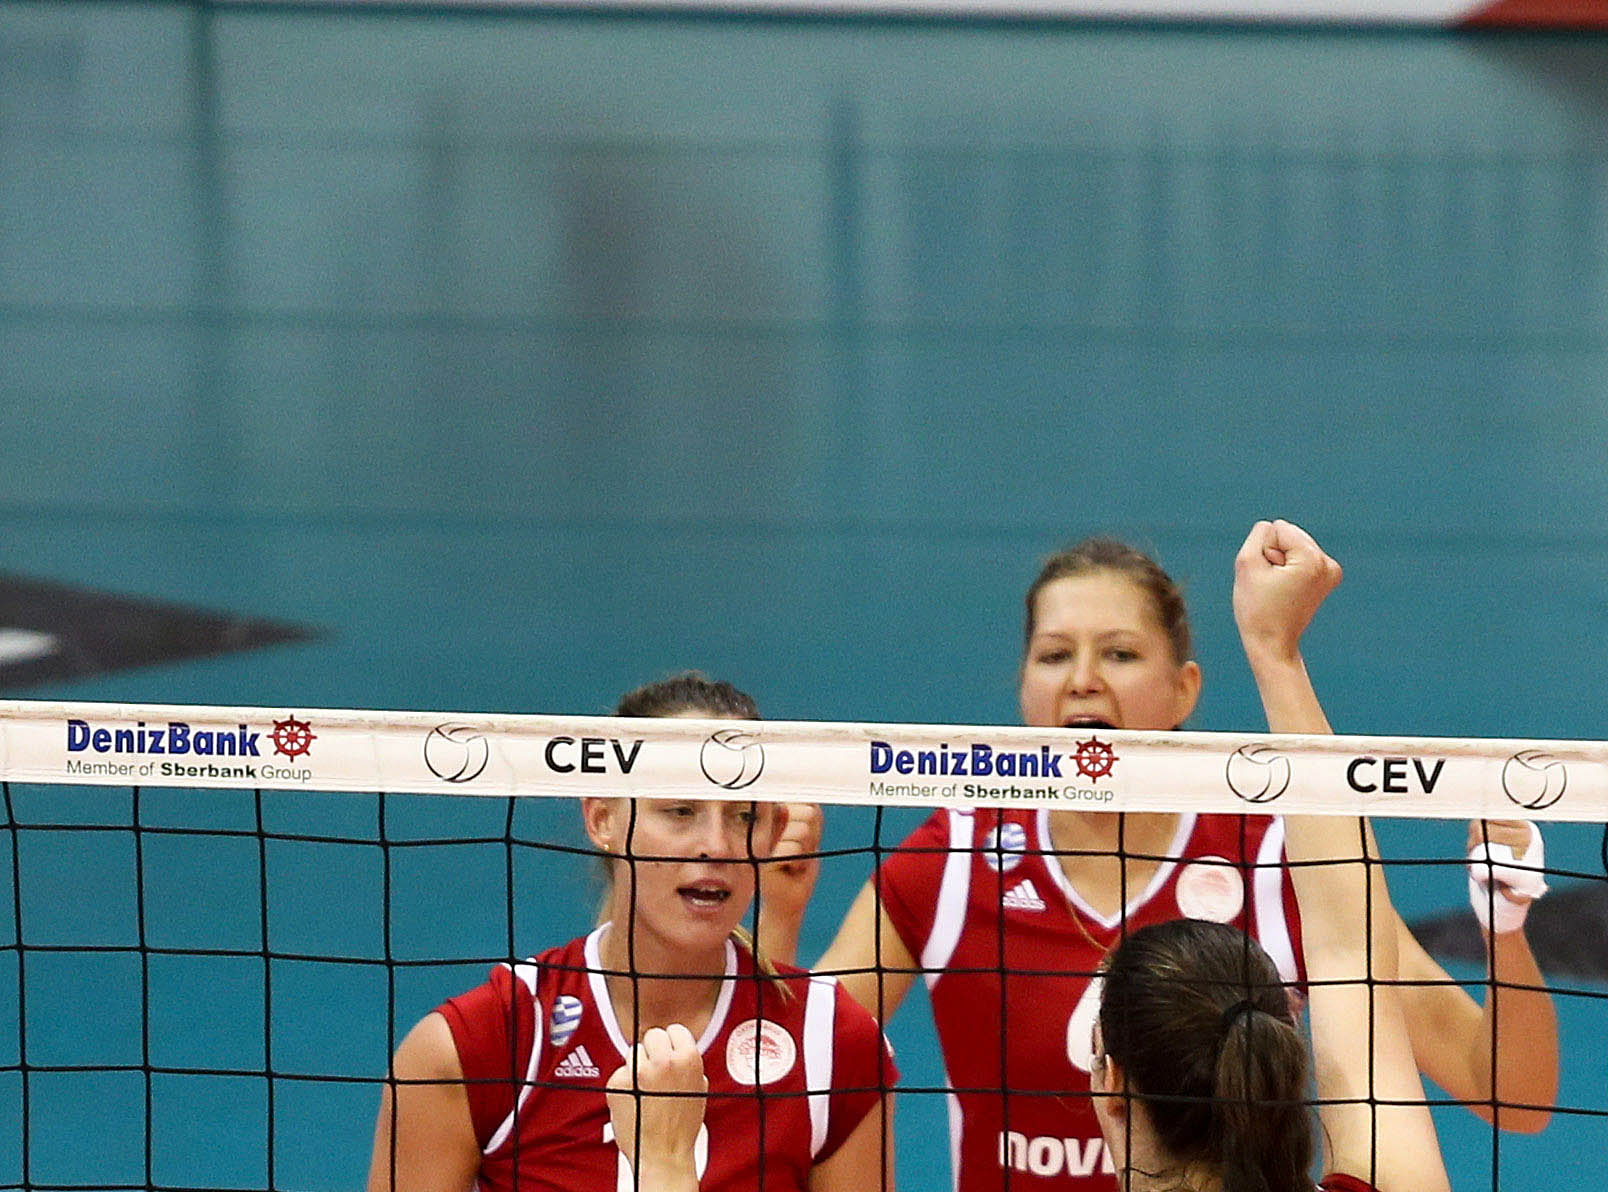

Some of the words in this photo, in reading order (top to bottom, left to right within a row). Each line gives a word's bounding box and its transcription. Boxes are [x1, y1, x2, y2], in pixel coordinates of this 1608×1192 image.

[67, 718, 260, 756] DenizBank
[544, 736, 644, 774] CEV
[67, 760, 135, 775] Member
[139, 760, 155, 776] of
[161, 762, 257, 778] Sberbank
[261, 765, 312, 782] Group
[870, 741, 1063, 778] DenizBank
[1346, 758, 1445, 794] CEV
[870, 782, 937, 797] Member
[942, 782, 957, 798] of
[964, 784, 1059, 799] Sberbank
[1063, 786, 1114, 803] Group
[554, 1066, 600, 1078] adidas
